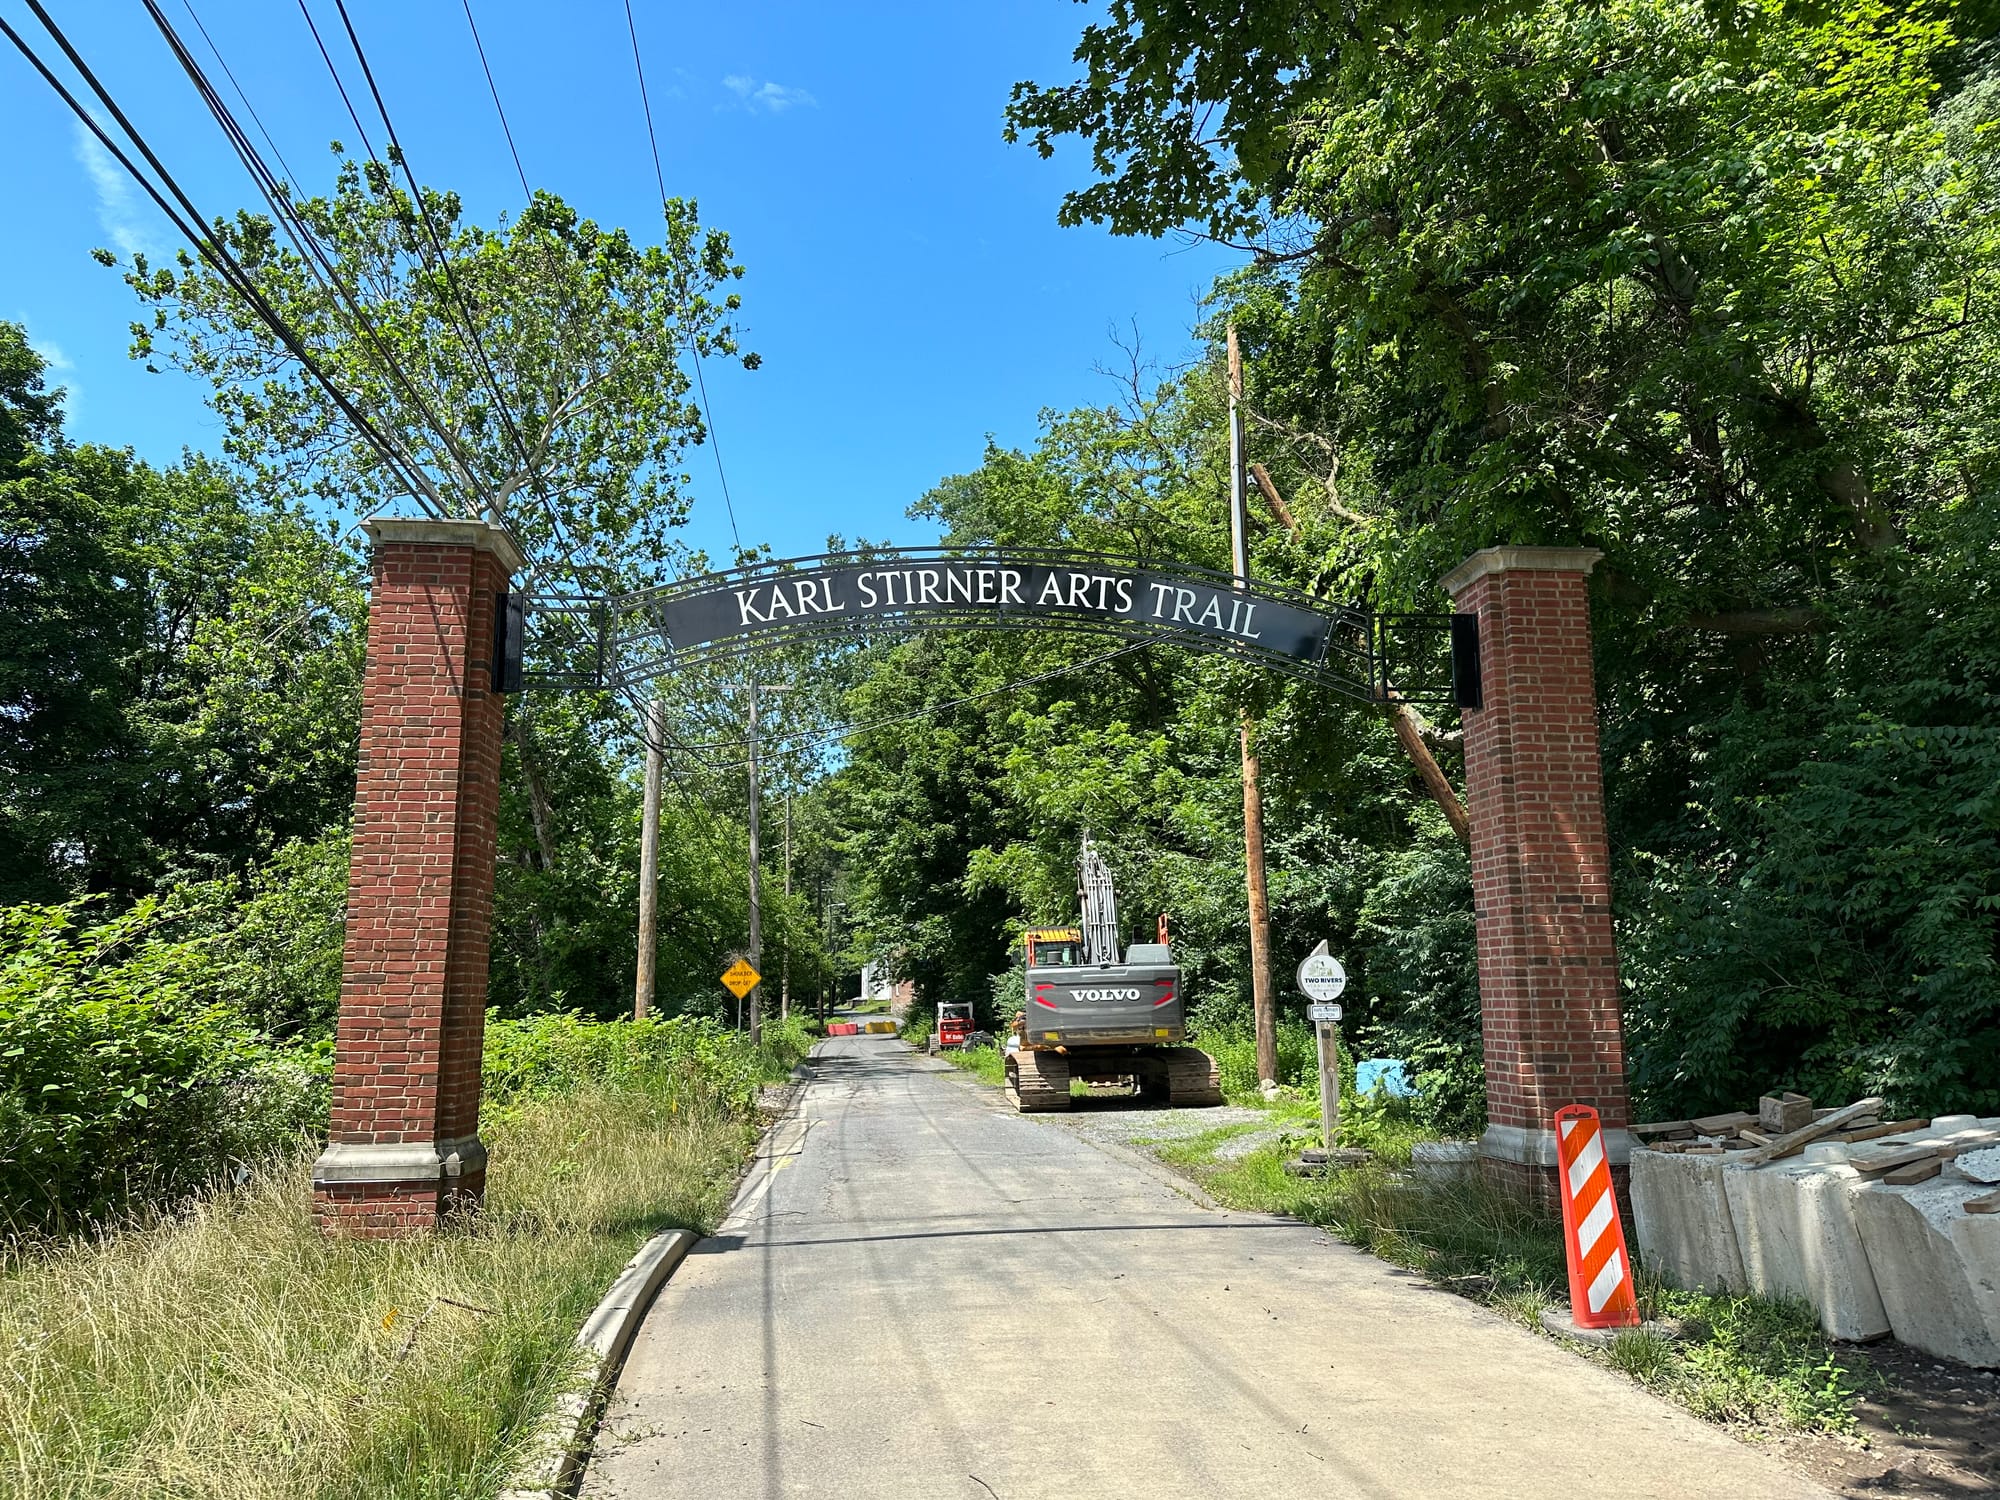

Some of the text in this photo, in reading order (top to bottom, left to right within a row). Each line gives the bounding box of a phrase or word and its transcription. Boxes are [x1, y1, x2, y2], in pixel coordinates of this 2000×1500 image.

[734, 568, 1261, 639] KARL STIRNER ARTS TRAIL
[1069, 988, 1141, 1002] VOLVO
